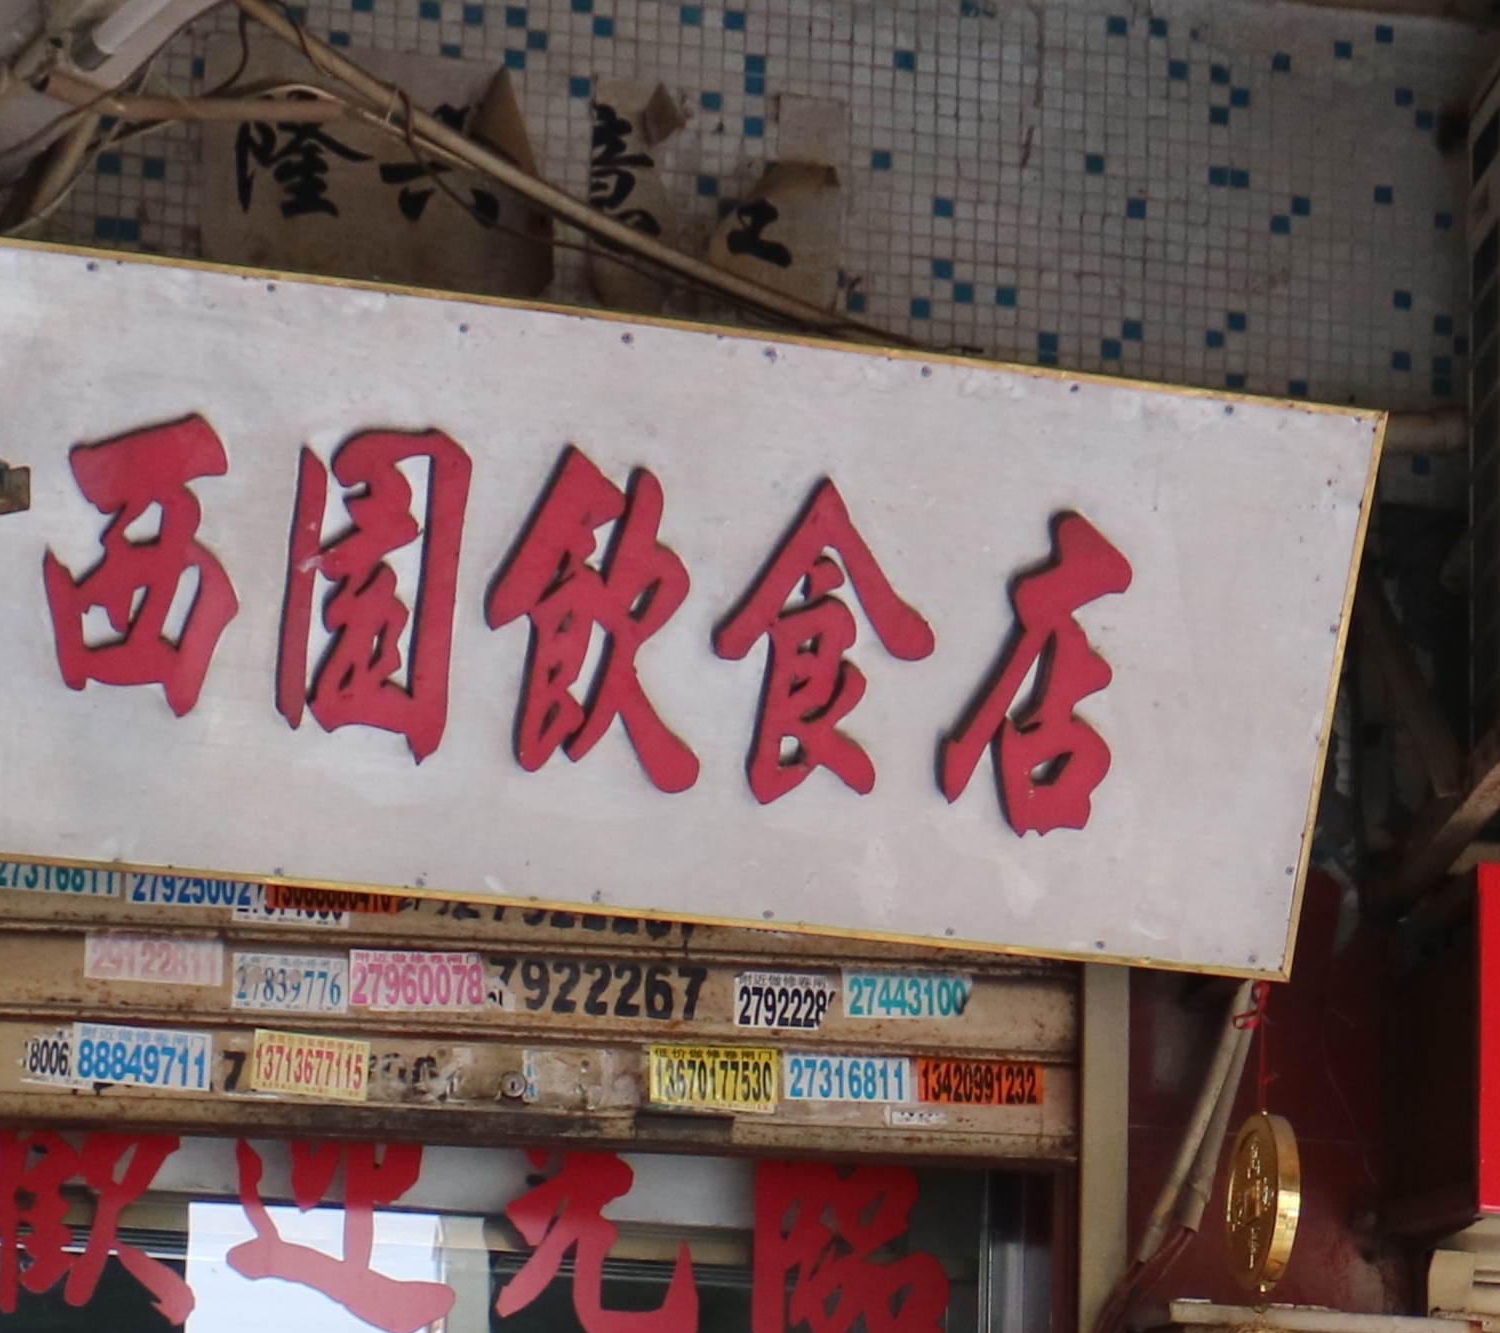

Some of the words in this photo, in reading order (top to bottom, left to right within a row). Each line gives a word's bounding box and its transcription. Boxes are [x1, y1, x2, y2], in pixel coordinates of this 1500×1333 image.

[351, 963, 485, 1006] 27960078
[848, 976, 968, 1018] 27443100
[76, 1038, 208, 1090] 88849711
[255, 1041, 363, 1090] 13713677115
[789, 1058, 904, 1101] 27316811
[920, 1065, 1037, 1104] 13420991232
